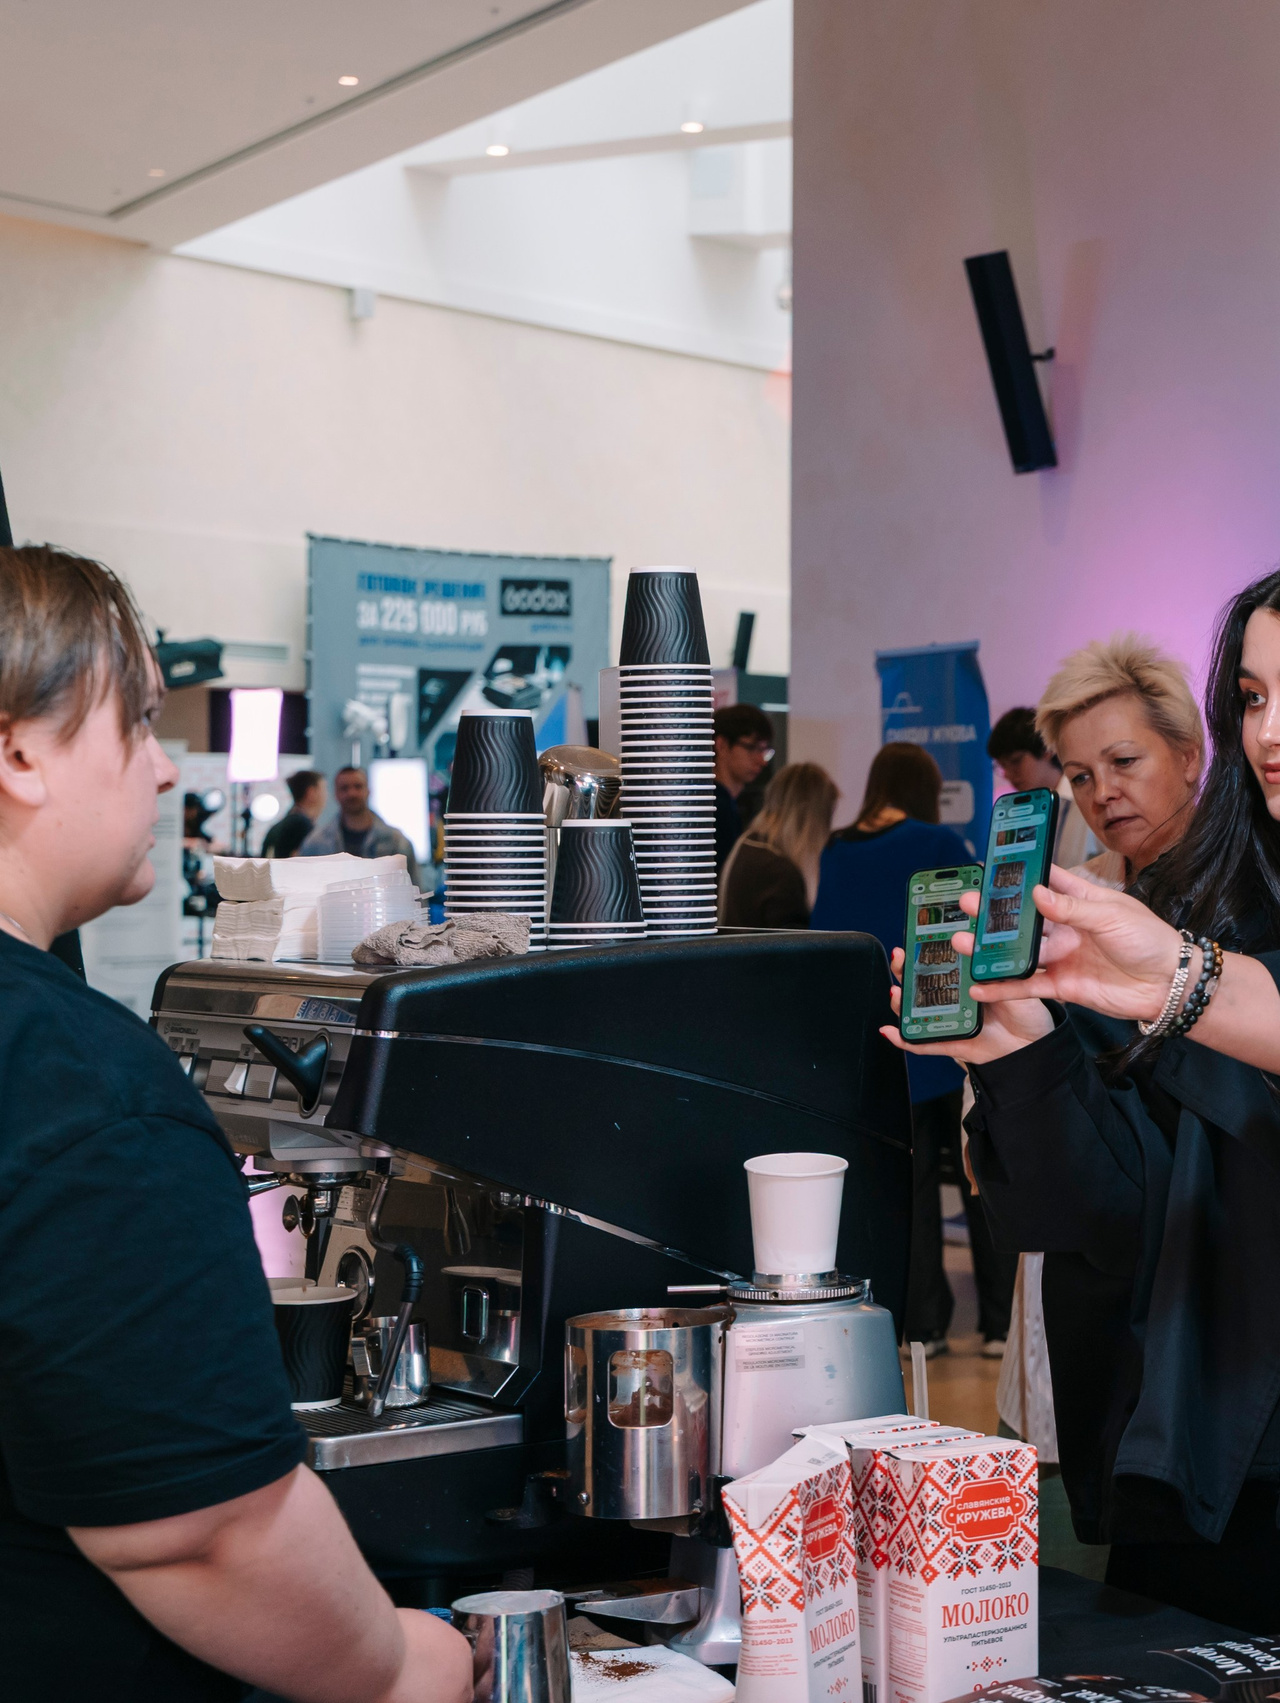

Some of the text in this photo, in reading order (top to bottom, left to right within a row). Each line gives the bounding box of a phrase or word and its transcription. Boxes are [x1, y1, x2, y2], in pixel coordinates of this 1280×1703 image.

[379, 596, 418, 634] 225
[420, 600, 458, 636] 000
[956, 1496, 1011, 1511] славянские
[956, 1506, 1014, 1524] КРУЖЕВА
[805, 1523, 838, 1545] КРУЖЕВА
[961, 1581, 1011, 1595] ГОСТ 31450-2013
[941, 1591, 1029, 1629] МОЛОКО
[809, 1608, 856, 1655] МОЛОКО
[943, 1622, 1028, 1643] УЛЬТРАПАСТЕРИЗОВАННОЕ
[971, 1636, 1003, 1647] ПИТЬЕВОЕ
